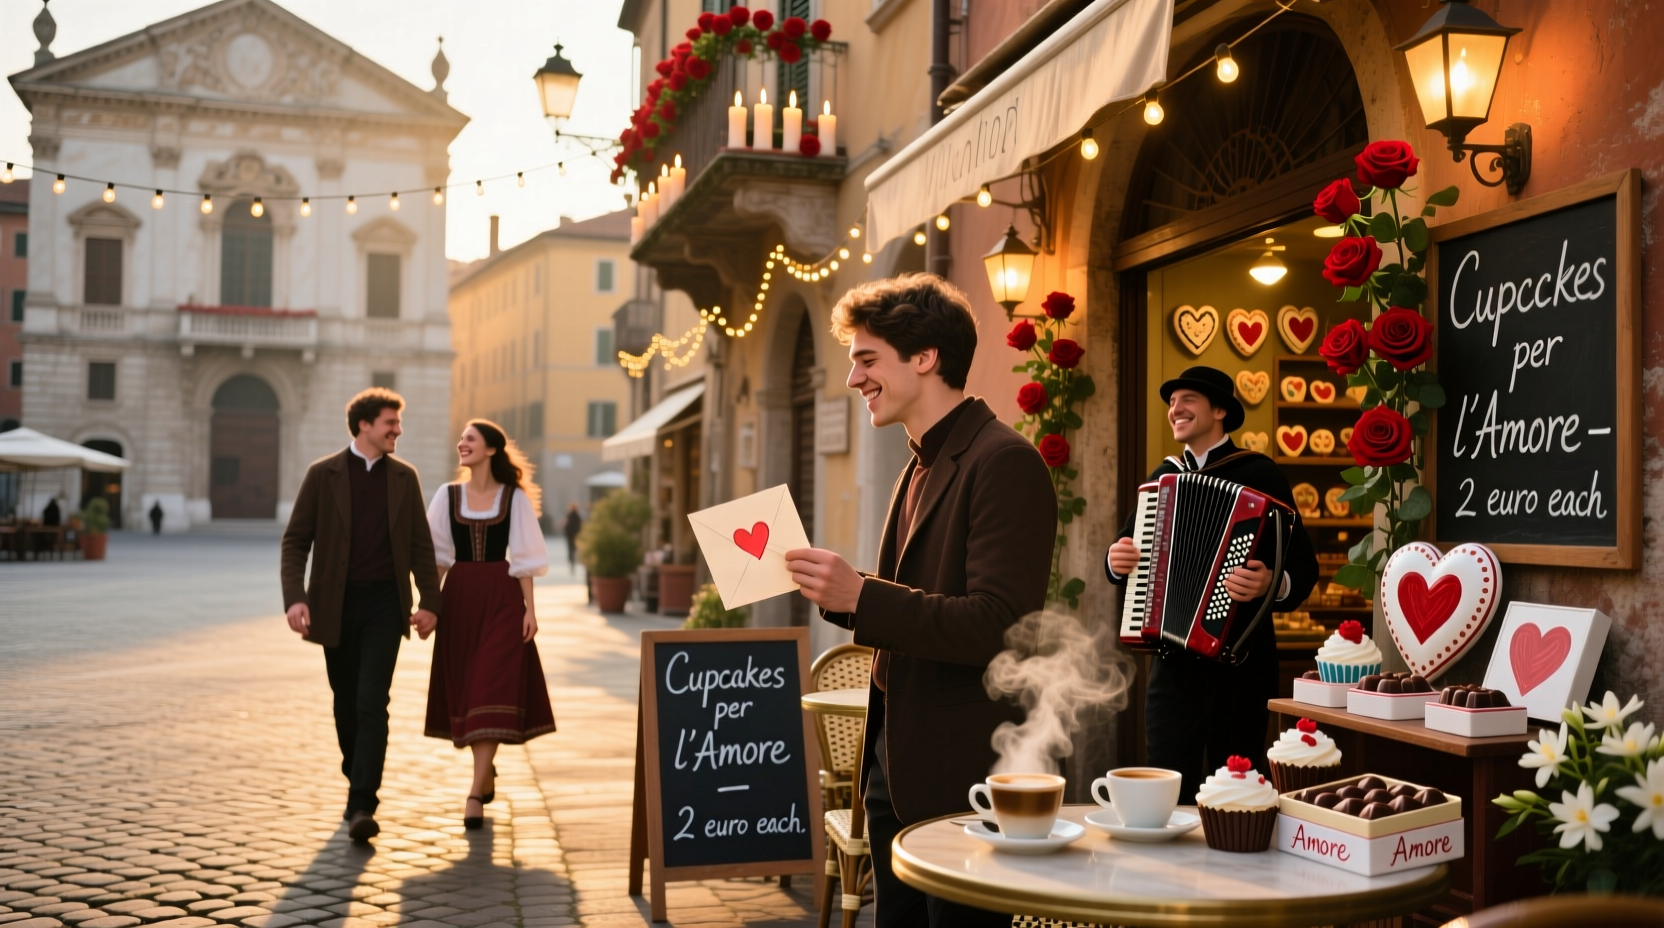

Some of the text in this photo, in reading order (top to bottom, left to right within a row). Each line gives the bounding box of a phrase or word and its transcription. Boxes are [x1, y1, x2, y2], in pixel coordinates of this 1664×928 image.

[1508, 334, 1564, 393] per
[1453, 389, 1582, 459] l'Amore
[1455, 469, 1608, 519] 2 euro each
[665, 651, 785, 708] Cupcakes
[713, 701, 754, 731] per
[674, 728, 791, 772] l'Amore
[673, 802, 807, 841] 2 euro each.
[1290, 824, 1351, 862] Amore
[1389, 834, 1453, 867] Amore
